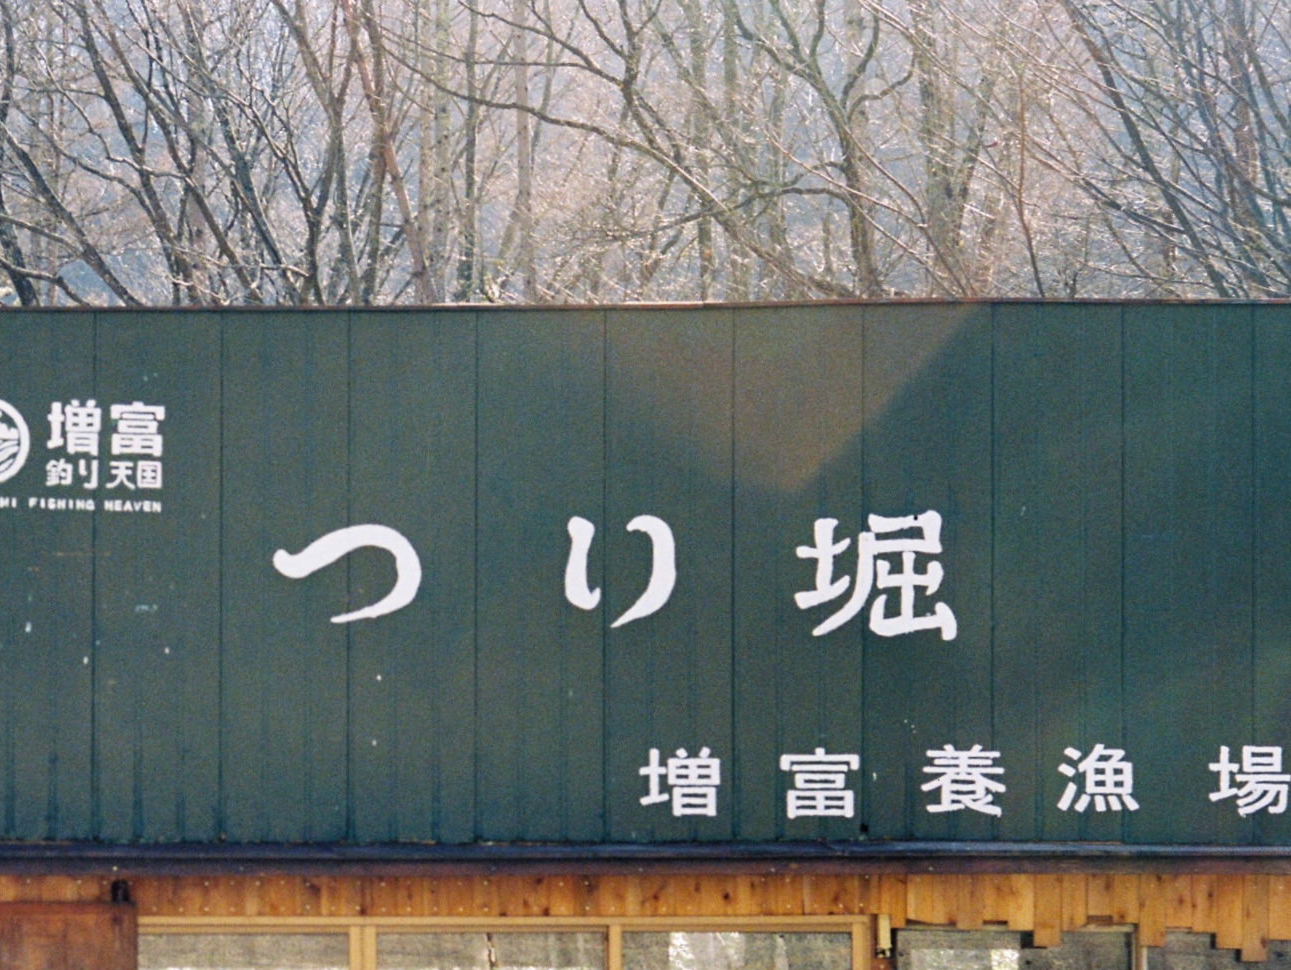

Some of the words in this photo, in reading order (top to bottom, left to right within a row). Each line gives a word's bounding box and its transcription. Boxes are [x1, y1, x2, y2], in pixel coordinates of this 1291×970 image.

[46, 399, 166, 457] 増富
[45, 458, 163, 490] 釣り天国
[28, 497, 96, 511] FISHING
[103, 499, 162, 513] HEAVEN
[272, 509, 958, 641] つり堀
[638, 742, 1290, 820] 増富養漁場
